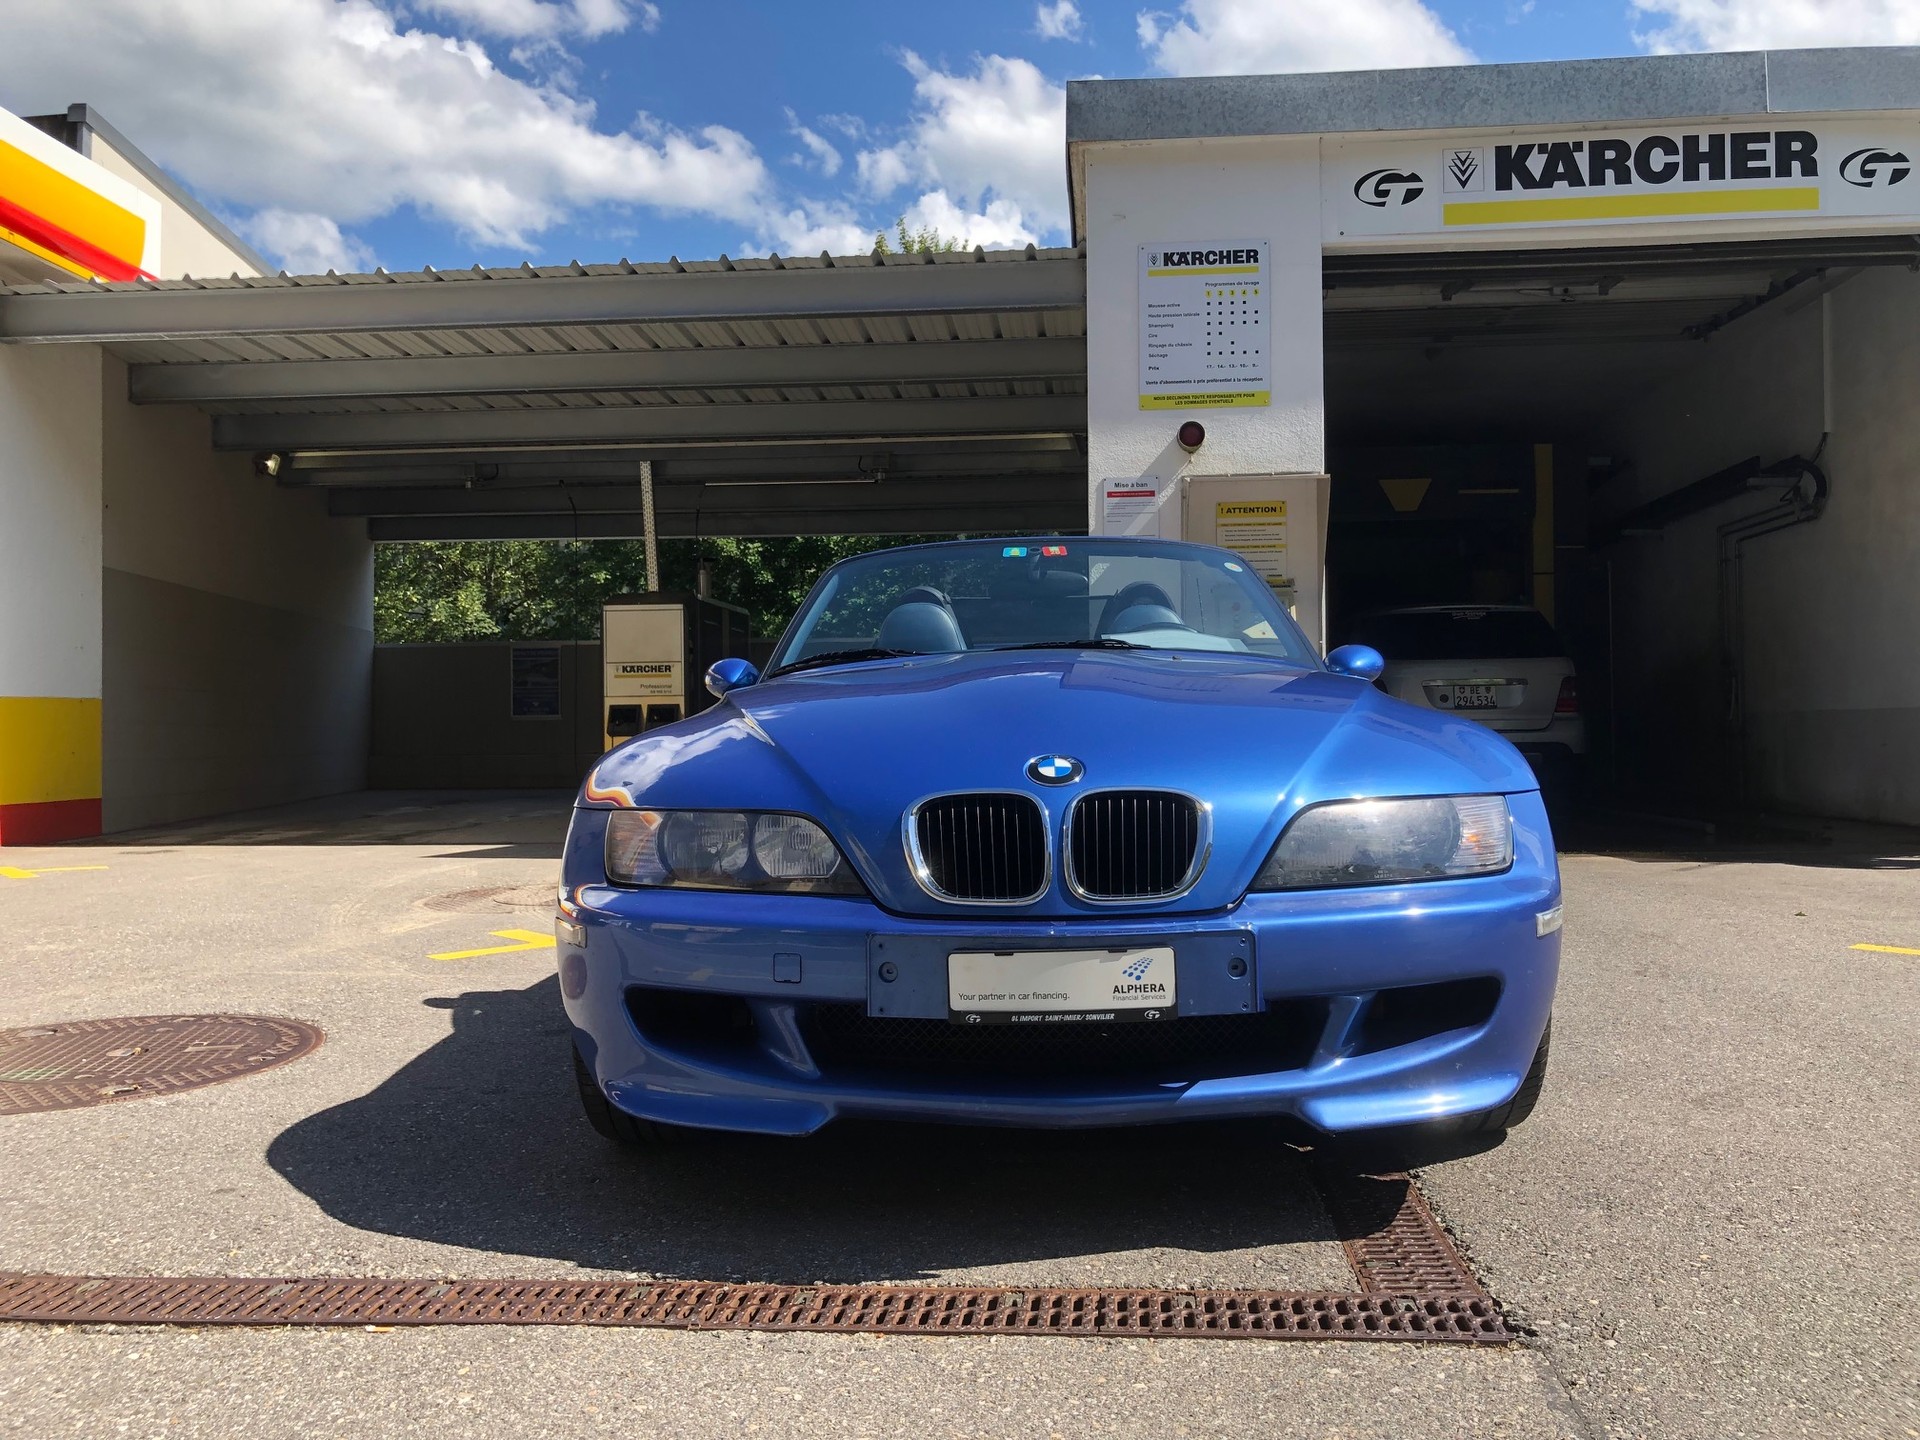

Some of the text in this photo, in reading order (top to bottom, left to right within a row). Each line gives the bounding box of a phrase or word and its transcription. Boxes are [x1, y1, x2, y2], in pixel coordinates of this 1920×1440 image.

[1494, 130, 1819, 192] KÄRCHER
[1163, 249, 1259, 267] KÄRCHER
[622, 664, 672, 673] KÄRCHER
[1112, 983, 1166, 994] ALPHERA
[958, 992, 976, 1001] Your
[978, 993, 1006, 1002] partner
[1008, 992, 1015, 1000] in
[1032, 992, 1070, 1001] financing.
